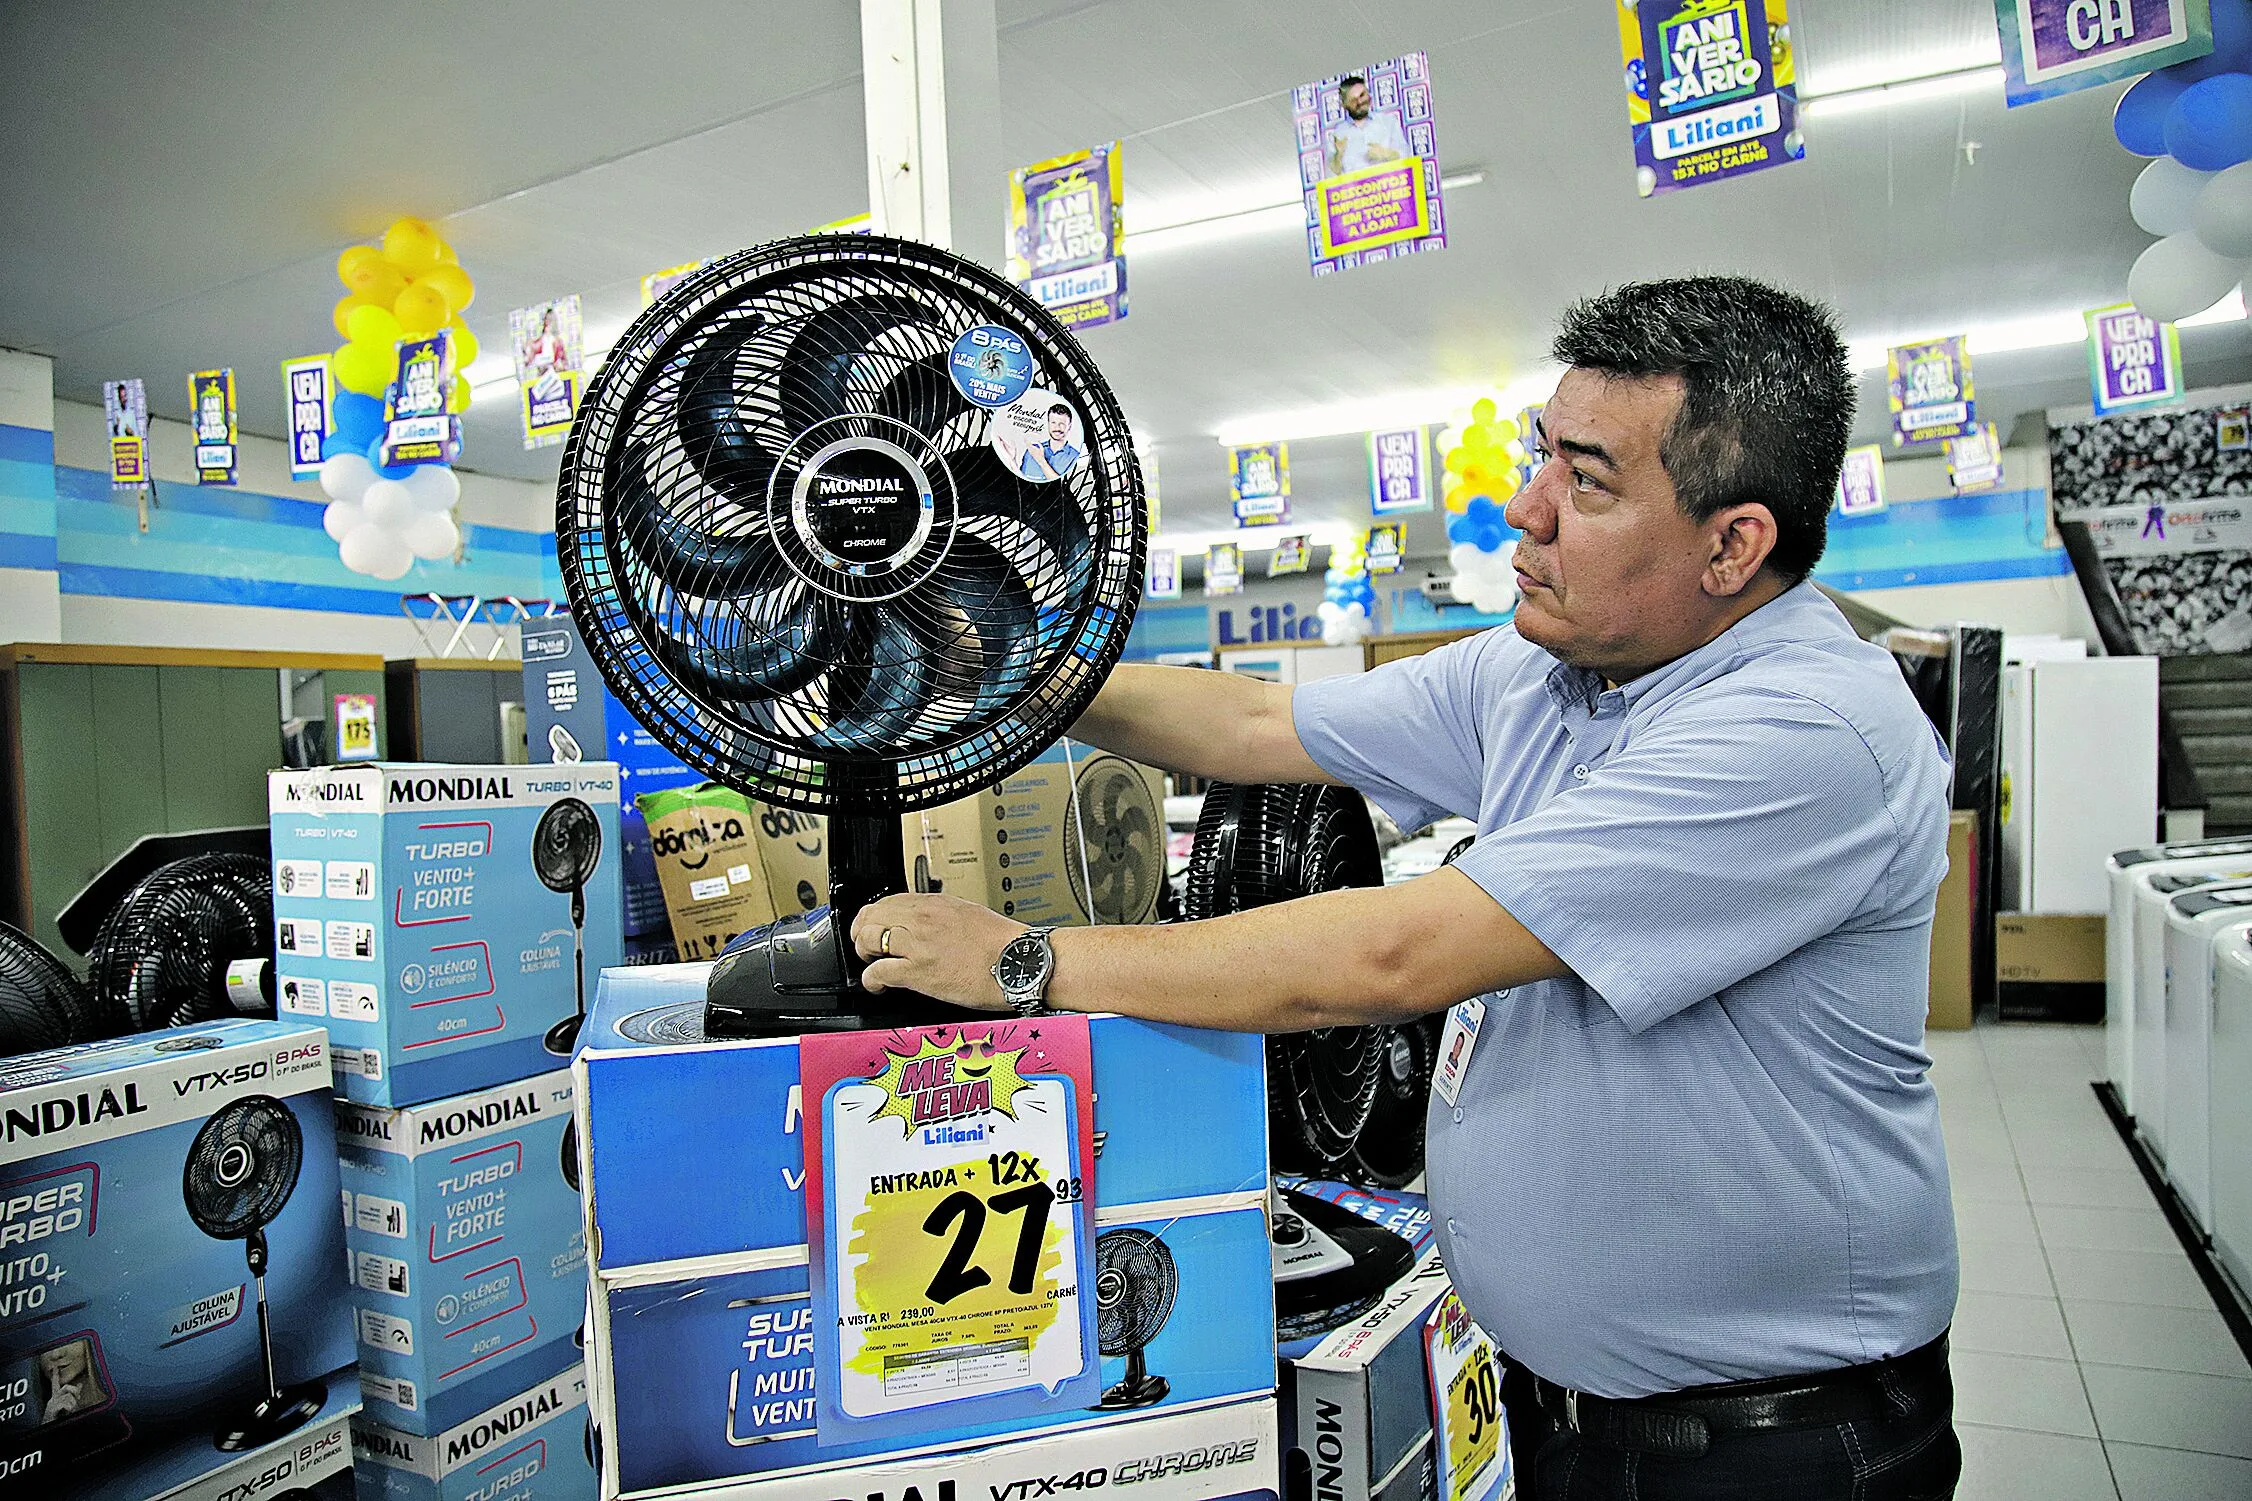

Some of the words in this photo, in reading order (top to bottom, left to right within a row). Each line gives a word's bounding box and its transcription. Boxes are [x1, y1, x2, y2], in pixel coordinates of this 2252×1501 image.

[1675, 12, 1735, 51] ANI
[1671, 37, 1743, 76] VER
[1659, 58, 1762, 107] SARIO
[1668, 105, 1764, 149] Liliani
[1698, 161, 1720, 176] NO
[1330, 174, 1409, 203] DESCONTOS
[1046, 212, 1095, 242] VER
[1342, 211, 1363, 226] EM
[1364, 203, 1402, 222] TODA
[1349, 225, 1362, 237] A
[1361, 215, 1400, 233] LOJA!
[1036, 231, 1109, 267] SARIO
[1041, 271, 1109, 302] Liliani
[971, 329, 991, 347] 8
[990, 335, 1023, 355] PÁS
[2106, 313, 2155, 344] VEM
[2111, 338, 2155, 371] PRA
[968, 378, 987, 391] 20%
[986, 381, 1007, 394] MAIS
[2119, 366, 2153, 396] CA
[1008, 404, 1047, 420] Mondial
[819, 478, 905, 495] MONDIAL
[828, 498, 862, 508] SUPER
[863, 496, 898, 505] TURBO
[852, 506, 876, 515] VTX
[843, 538, 887, 548] CHROME
[1219, 602, 1324, 646] Lilia
[389, 777, 514, 803] MONDIAL
[526, 781, 572, 793] TURBO
[404, 840, 485, 861] TURBO
[413, 886, 475, 911] FORTE
[428, 958, 478, 978] SILÊNCIO
[519, 945, 562, 964] COLUNA
[437, 1018, 468, 1032] 40cm
[1456, 1004, 1479, 1034] Liliani
[896, 1055, 957, 1097] ME
[0, 1082, 148, 1143] NDIAL
[173, 1060, 268, 1097] VTX-50
[275, 1051, 289, 1065] 8
[291, 1044, 321, 1062] PÁS
[912, 1077, 992, 1125] LEVA
[420, 1093, 541, 1145] MONDIAL
[924, 1123, 985, 1146] Liliani
[437, 1160, 514, 1197] TURBO
[870, 1167, 958, 1195] ENTRADA
[964, 1168, 976, 1181] +
[446, 1206, 506, 1244] FORTE
[922, 1181, 1056, 1305] 27
[1056, 1177, 1083, 1200] 93
[1283, 1251, 1325, 1265] MONDIAL
[191, 1291, 235, 1316] COLUNA
[847, 1314, 878, 1327] VISTA
[900, 1306, 935, 1321] 239,00
[170, 1307, 231, 1337] AJUSTÁVEL
[881, 1322, 910, 1331] MONDIAL
[911, 1319, 929, 1328] MESA
[929, 1316, 946, 1325] 40CM
[946, 1313, 967, 1323] VTX-40
[967, 1310, 994, 1320] CHROME
[470, 1335, 501, 1354] 40cm
[742, 1333, 815, 1362] TUR
[751, 1398, 817, 1427] VENT
[1464, 1362, 1498, 1446] 30
[447, 1387, 563, 1464] MONDIAL
[299, 1445, 312, 1462] 8
[314, 1430, 342, 1455] PÁS
[989, 1467, 1107, 1501] VTX-40
[1112, 1438, 1258, 1487] CHROME
